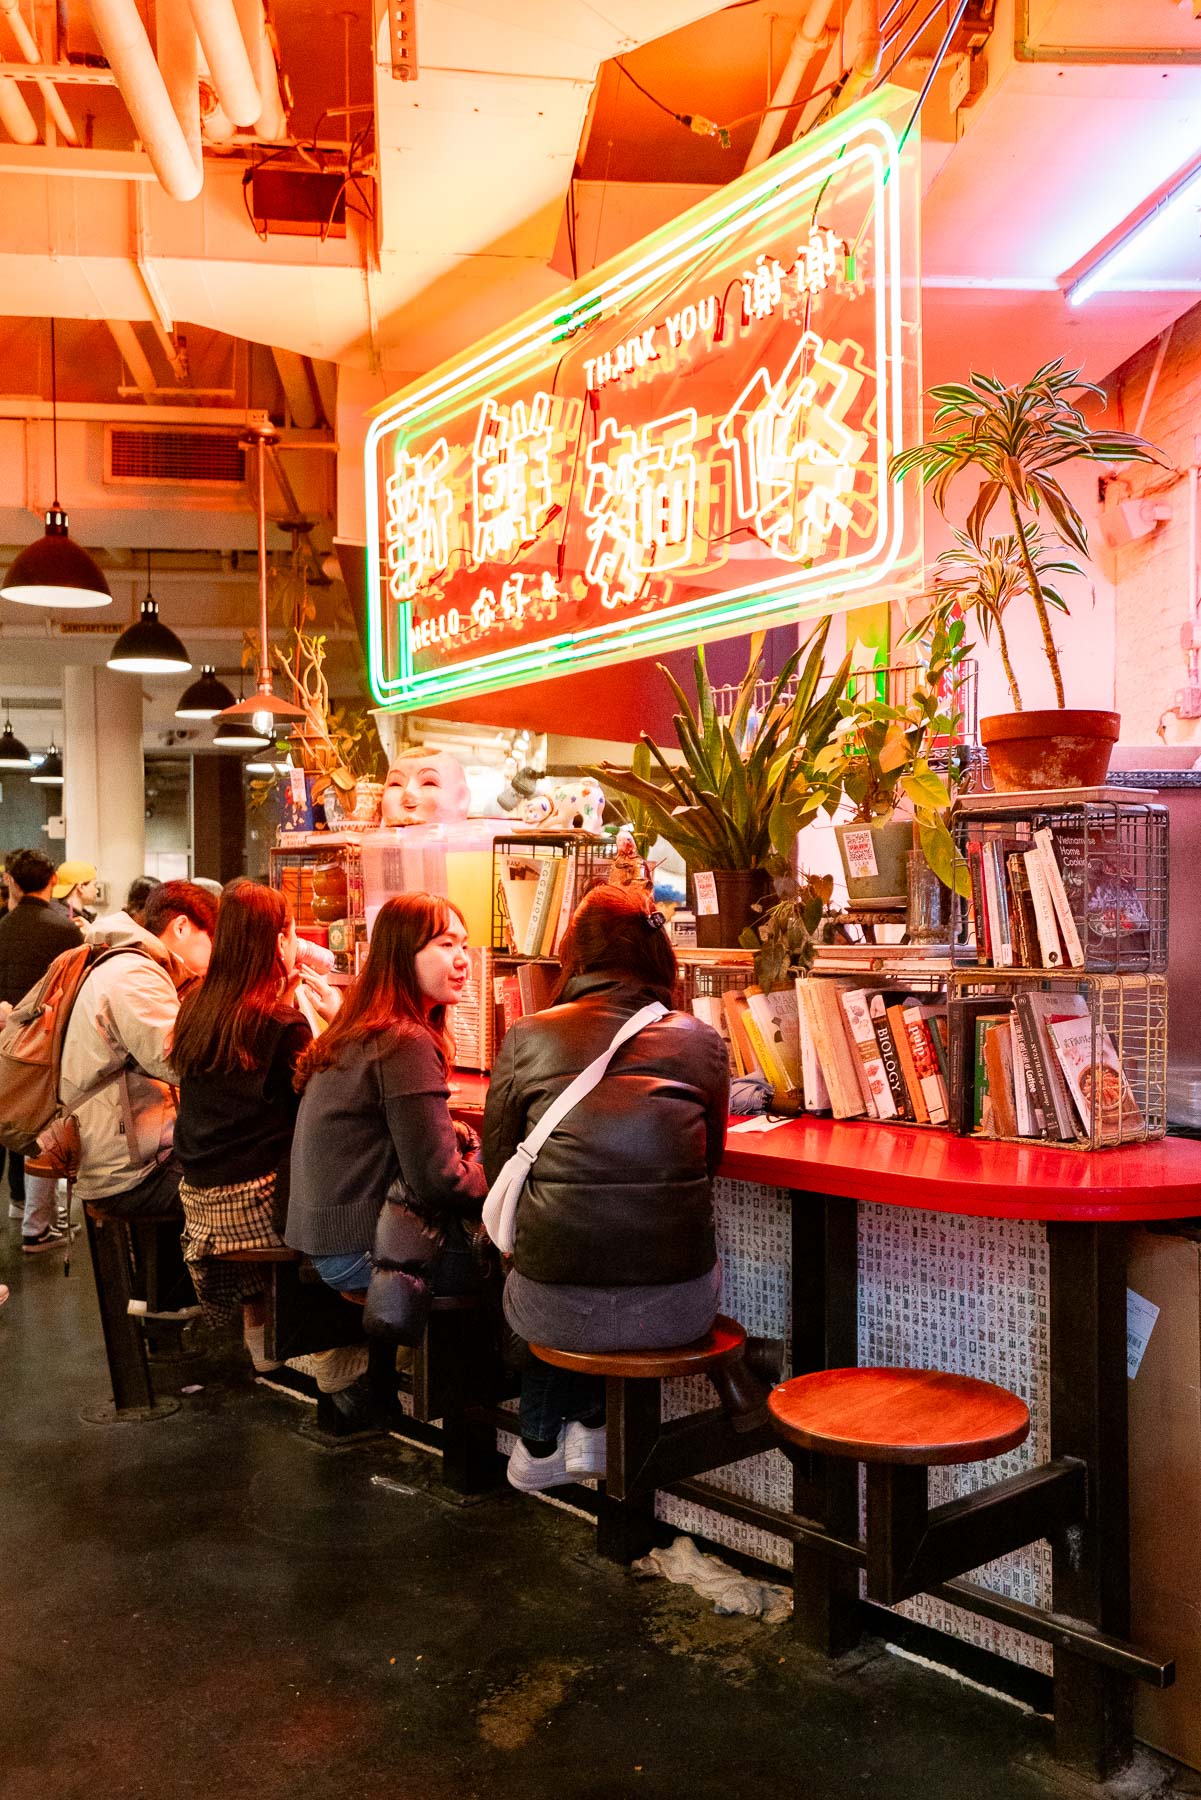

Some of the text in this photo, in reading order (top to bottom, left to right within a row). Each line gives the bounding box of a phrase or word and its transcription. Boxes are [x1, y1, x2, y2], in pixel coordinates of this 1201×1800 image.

[582, 325, 657, 391] THANK
[665, 295, 715, 348] YOU
[408, 607, 460, 652] HELLO
[471, 572, 531, 628] 你好
[1056, 835, 1096, 845] Vietnamse
[1060, 847, 1081, 856] Home
[908, 1024, 928, 1058] pulp
[878, 1027, 901, 1092] BIOLOGY
[1028, 1042, 1043, 1077] PUBLICAN
[1024, 1068, 1037, 1094] Coffee
